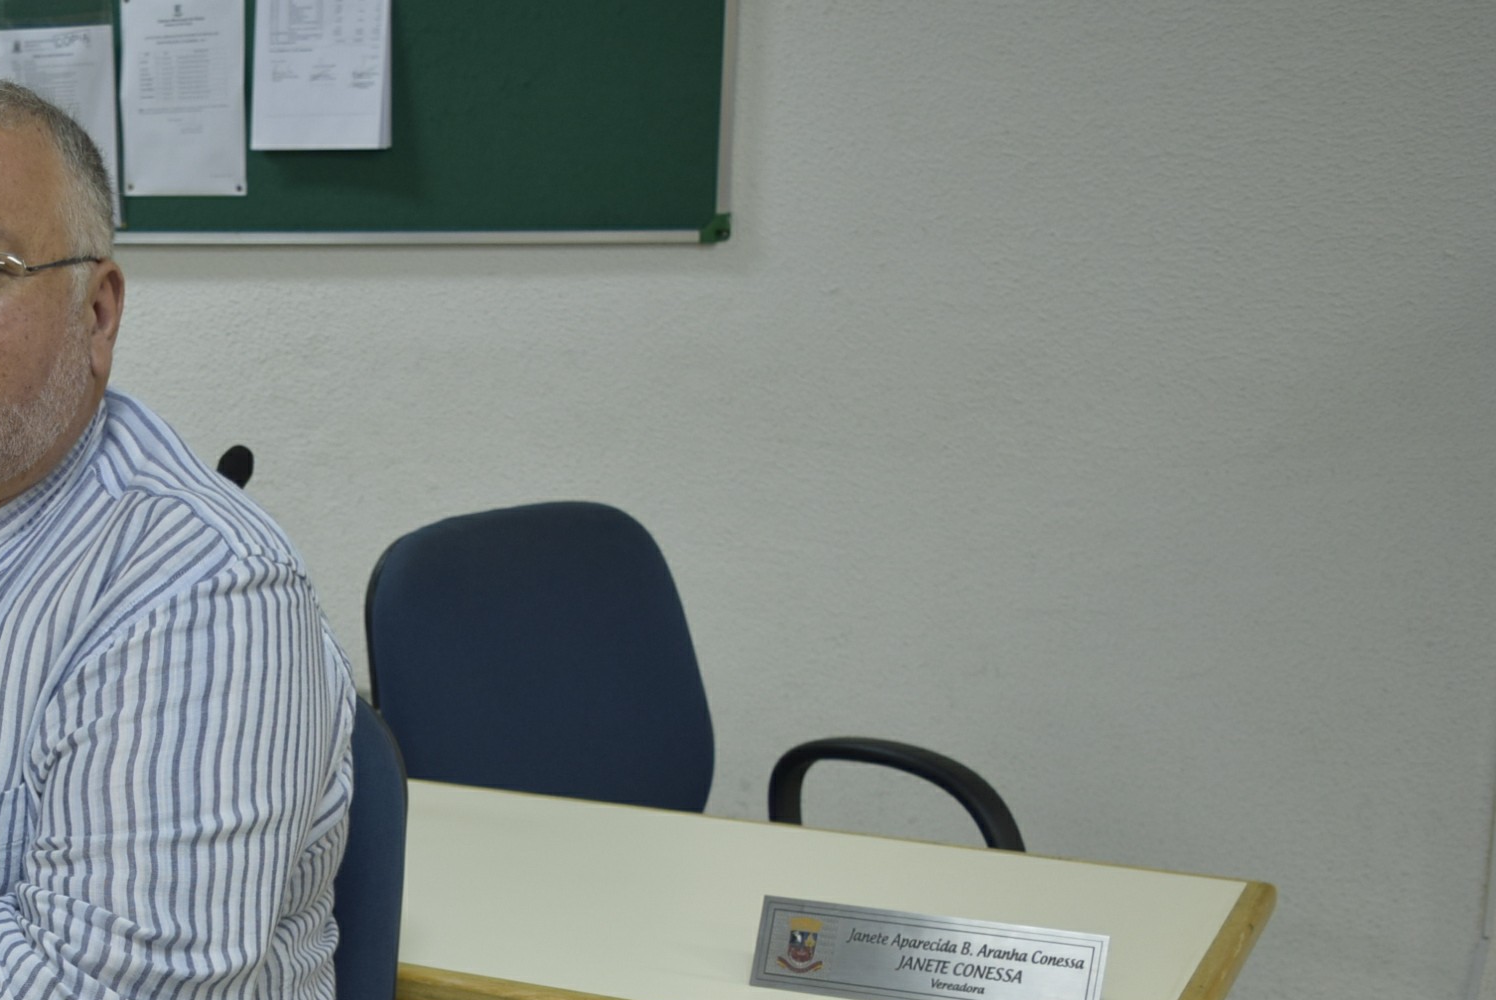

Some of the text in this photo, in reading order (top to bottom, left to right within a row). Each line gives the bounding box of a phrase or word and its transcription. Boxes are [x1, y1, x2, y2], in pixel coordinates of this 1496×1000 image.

[846, 927, 1085, 970] Janete Aparecida B. Aranha Conessa
[895, 955, 1023, 985] JANETE CONESSA
[930, 978, 985, 995] Vereadora
